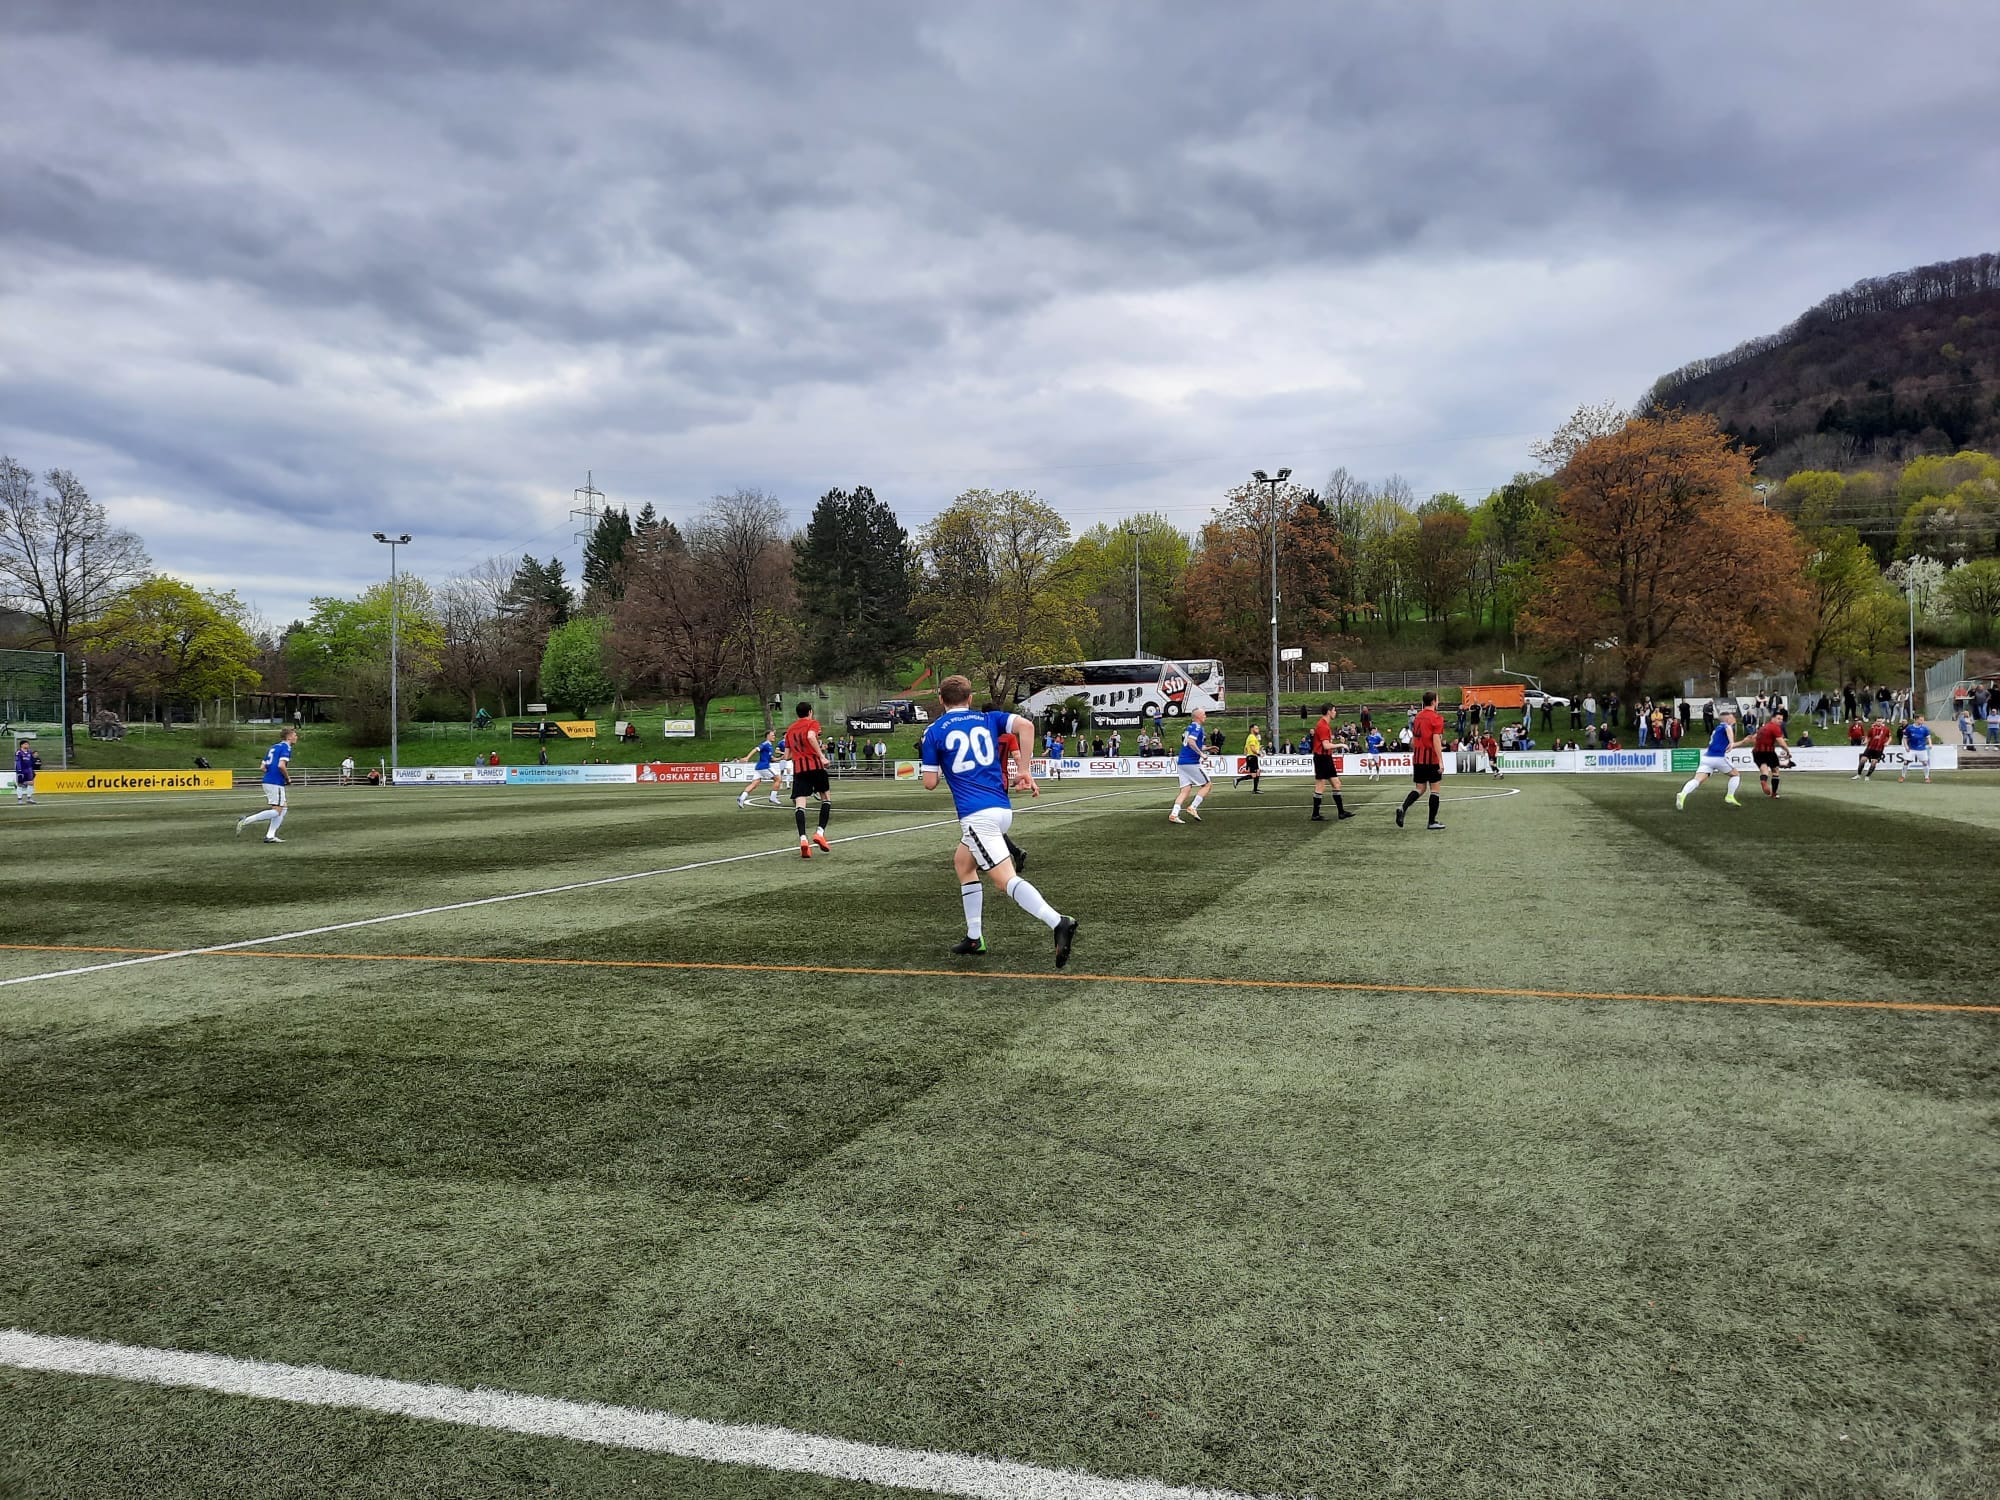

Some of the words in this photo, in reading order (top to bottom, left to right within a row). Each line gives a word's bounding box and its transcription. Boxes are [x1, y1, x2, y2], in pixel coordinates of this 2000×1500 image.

[861, 720, 892, 729] hummel
[1106, 715, 1140, 725] hummel
[945, 726, 995, 774] 20
[266, 748, 276, 765] 5
[1598, 752, 1656, 767] mollenkopf
[1090, 761, 1119, 769] ESSL
[1137, 761, 1167, 769] ESSL
[1201, 760, 1216, 768] SL
[1259, 758, 1272, 766] ULI
[1275, 758, 1313, 766] KEPPLER
[1498, 755, 1556, 768] MOLLENKOPF
[659, 773, 690, 781] OSKAR
[693, 772, 718, 780] ZEEB
[55, 774, 215, 789] www.druckerei-raisch.de
